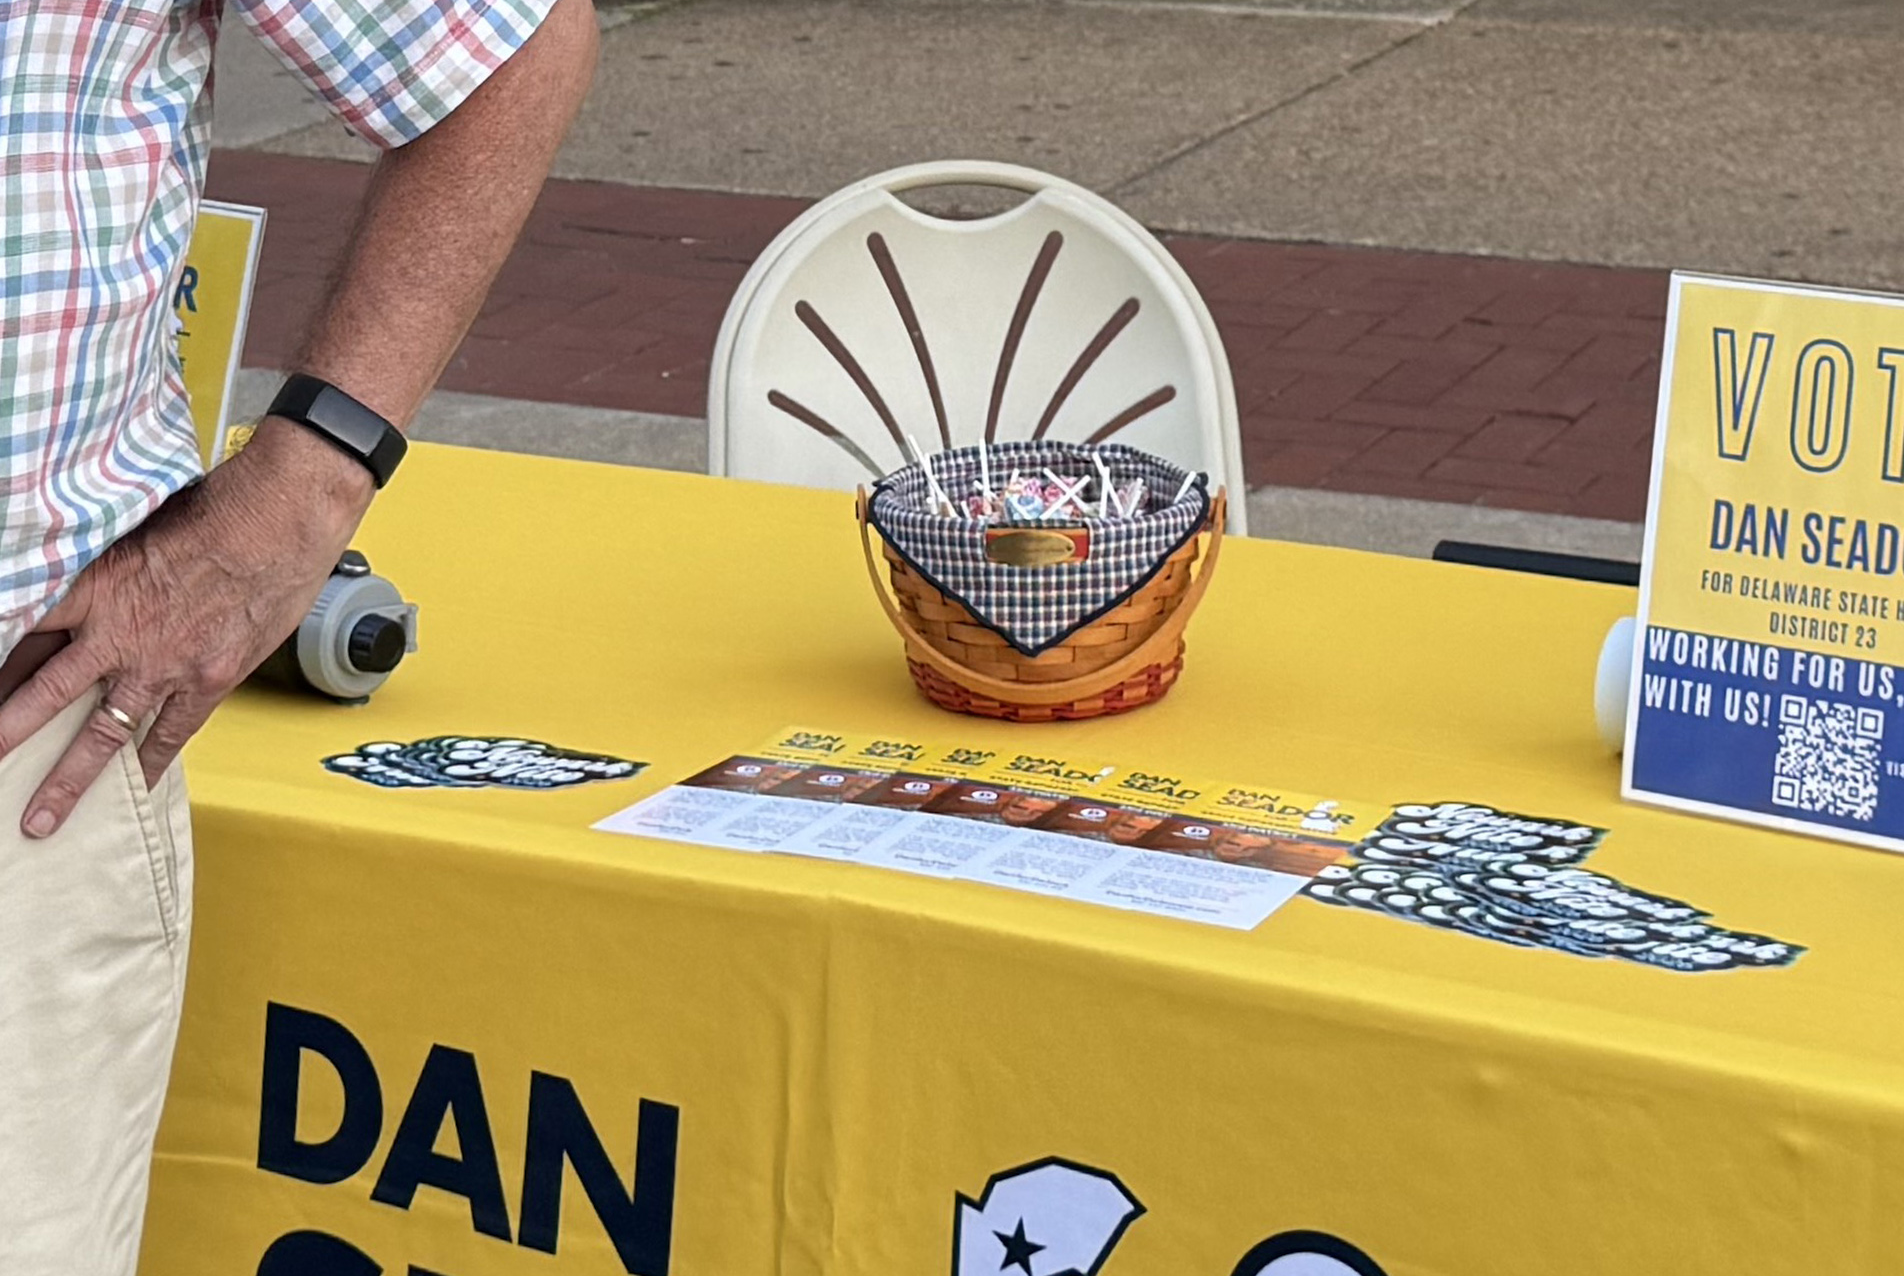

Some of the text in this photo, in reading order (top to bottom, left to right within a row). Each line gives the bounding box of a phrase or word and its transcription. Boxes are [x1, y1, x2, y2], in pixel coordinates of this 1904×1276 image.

[1709, 499, 1789, 561] DAN
[1701, 569, 1734, 595] FOR
[1740, 574, 1832, 611] DELAWARE
[1838, 590, 1889, 620] STATE
[1769, 611, 1878, 650] DISTRICT 23
[1648, 627, 1904, 708] WORKING FOR US,
[1644, 673, 1771, 728] WITH US!
[1117, 778, 1201, 800] SEAD
[1216, 795, 1356, 826] SEADOR
